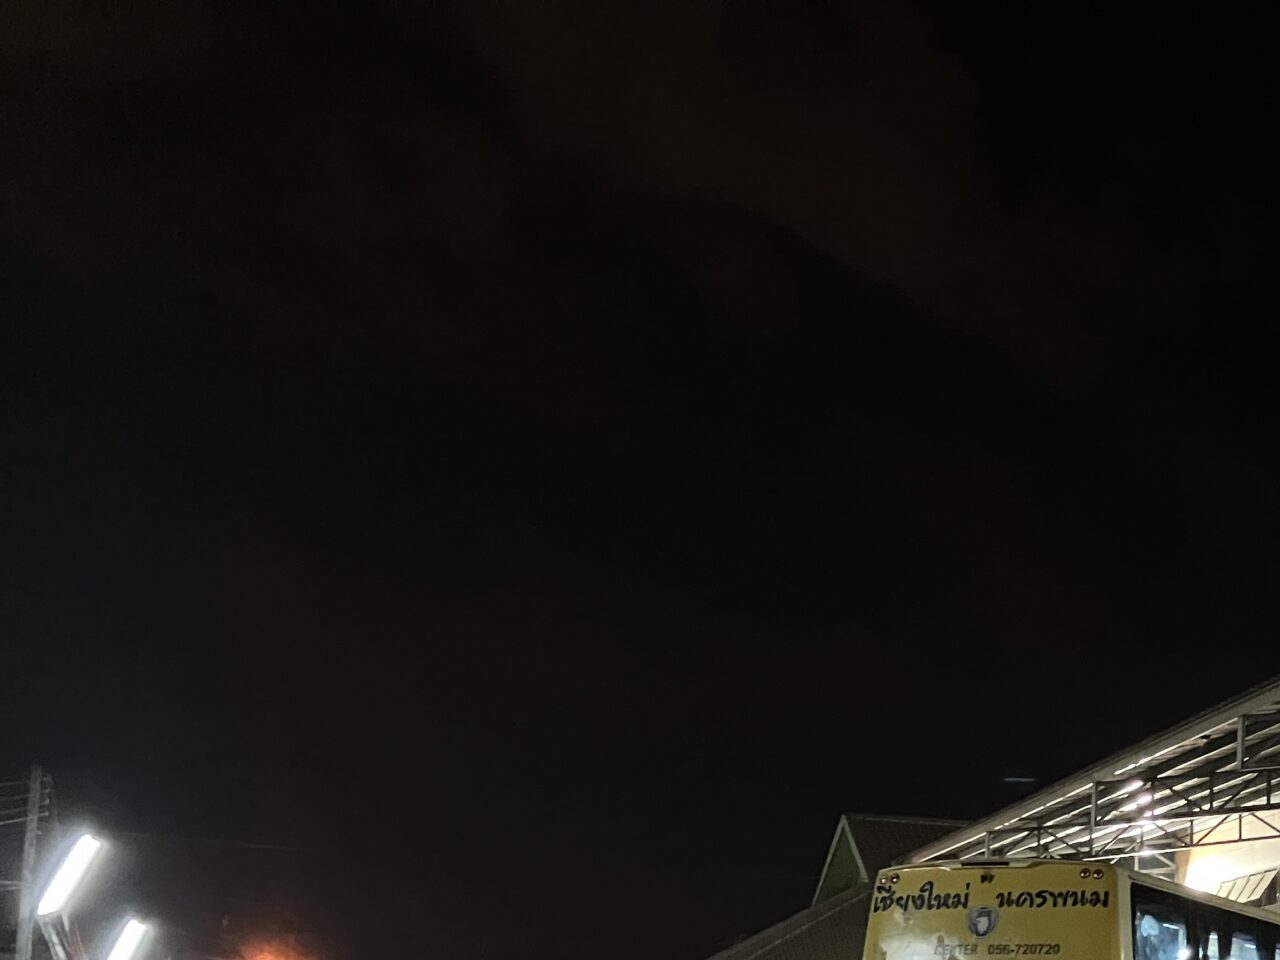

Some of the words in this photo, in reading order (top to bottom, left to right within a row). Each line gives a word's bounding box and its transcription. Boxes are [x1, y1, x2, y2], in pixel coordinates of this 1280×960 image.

[873, 881, 971, 913] เชียงใหม่
[995, 889, 1109, 908] นครพนม
